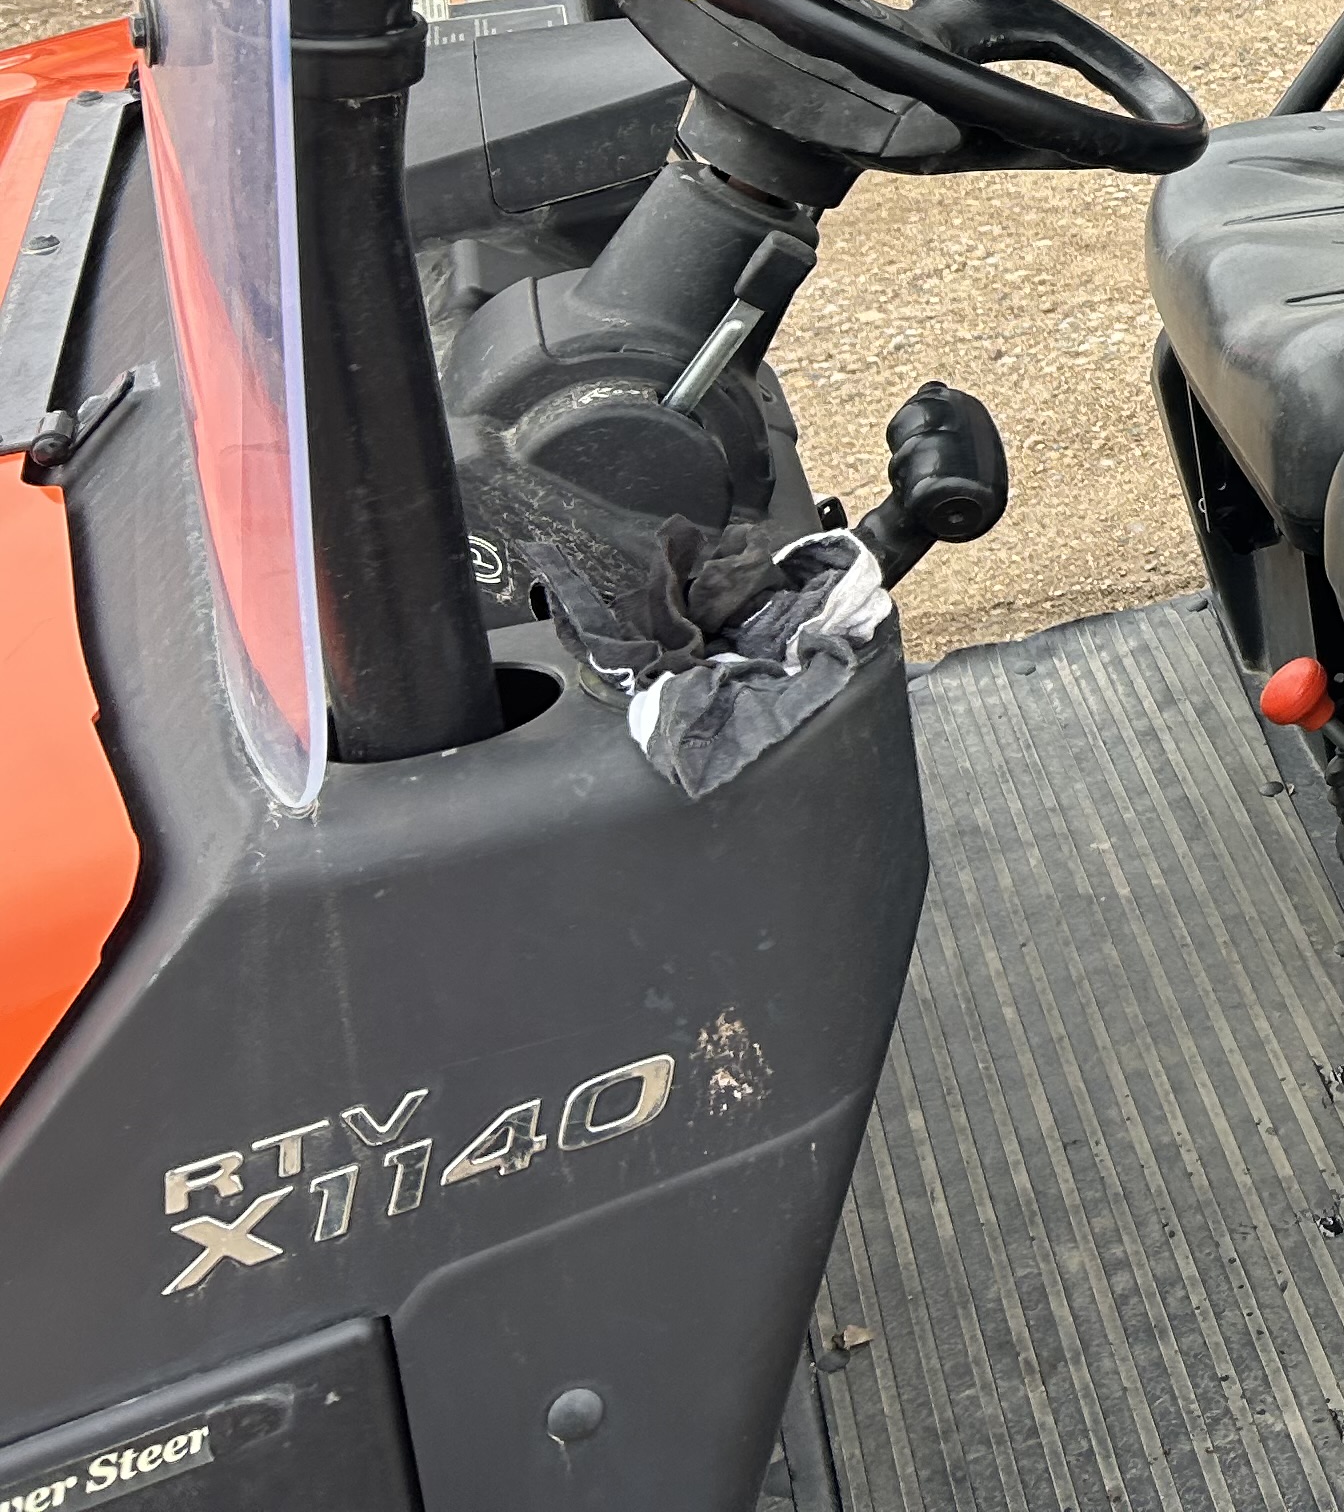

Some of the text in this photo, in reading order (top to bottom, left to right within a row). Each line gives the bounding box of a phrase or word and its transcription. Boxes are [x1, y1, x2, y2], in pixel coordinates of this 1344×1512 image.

[161, 1054, 675, 1296] X1140
[164, 1088, 428, 1215] RTV
[86, 1425, 210, 1494] Steer
